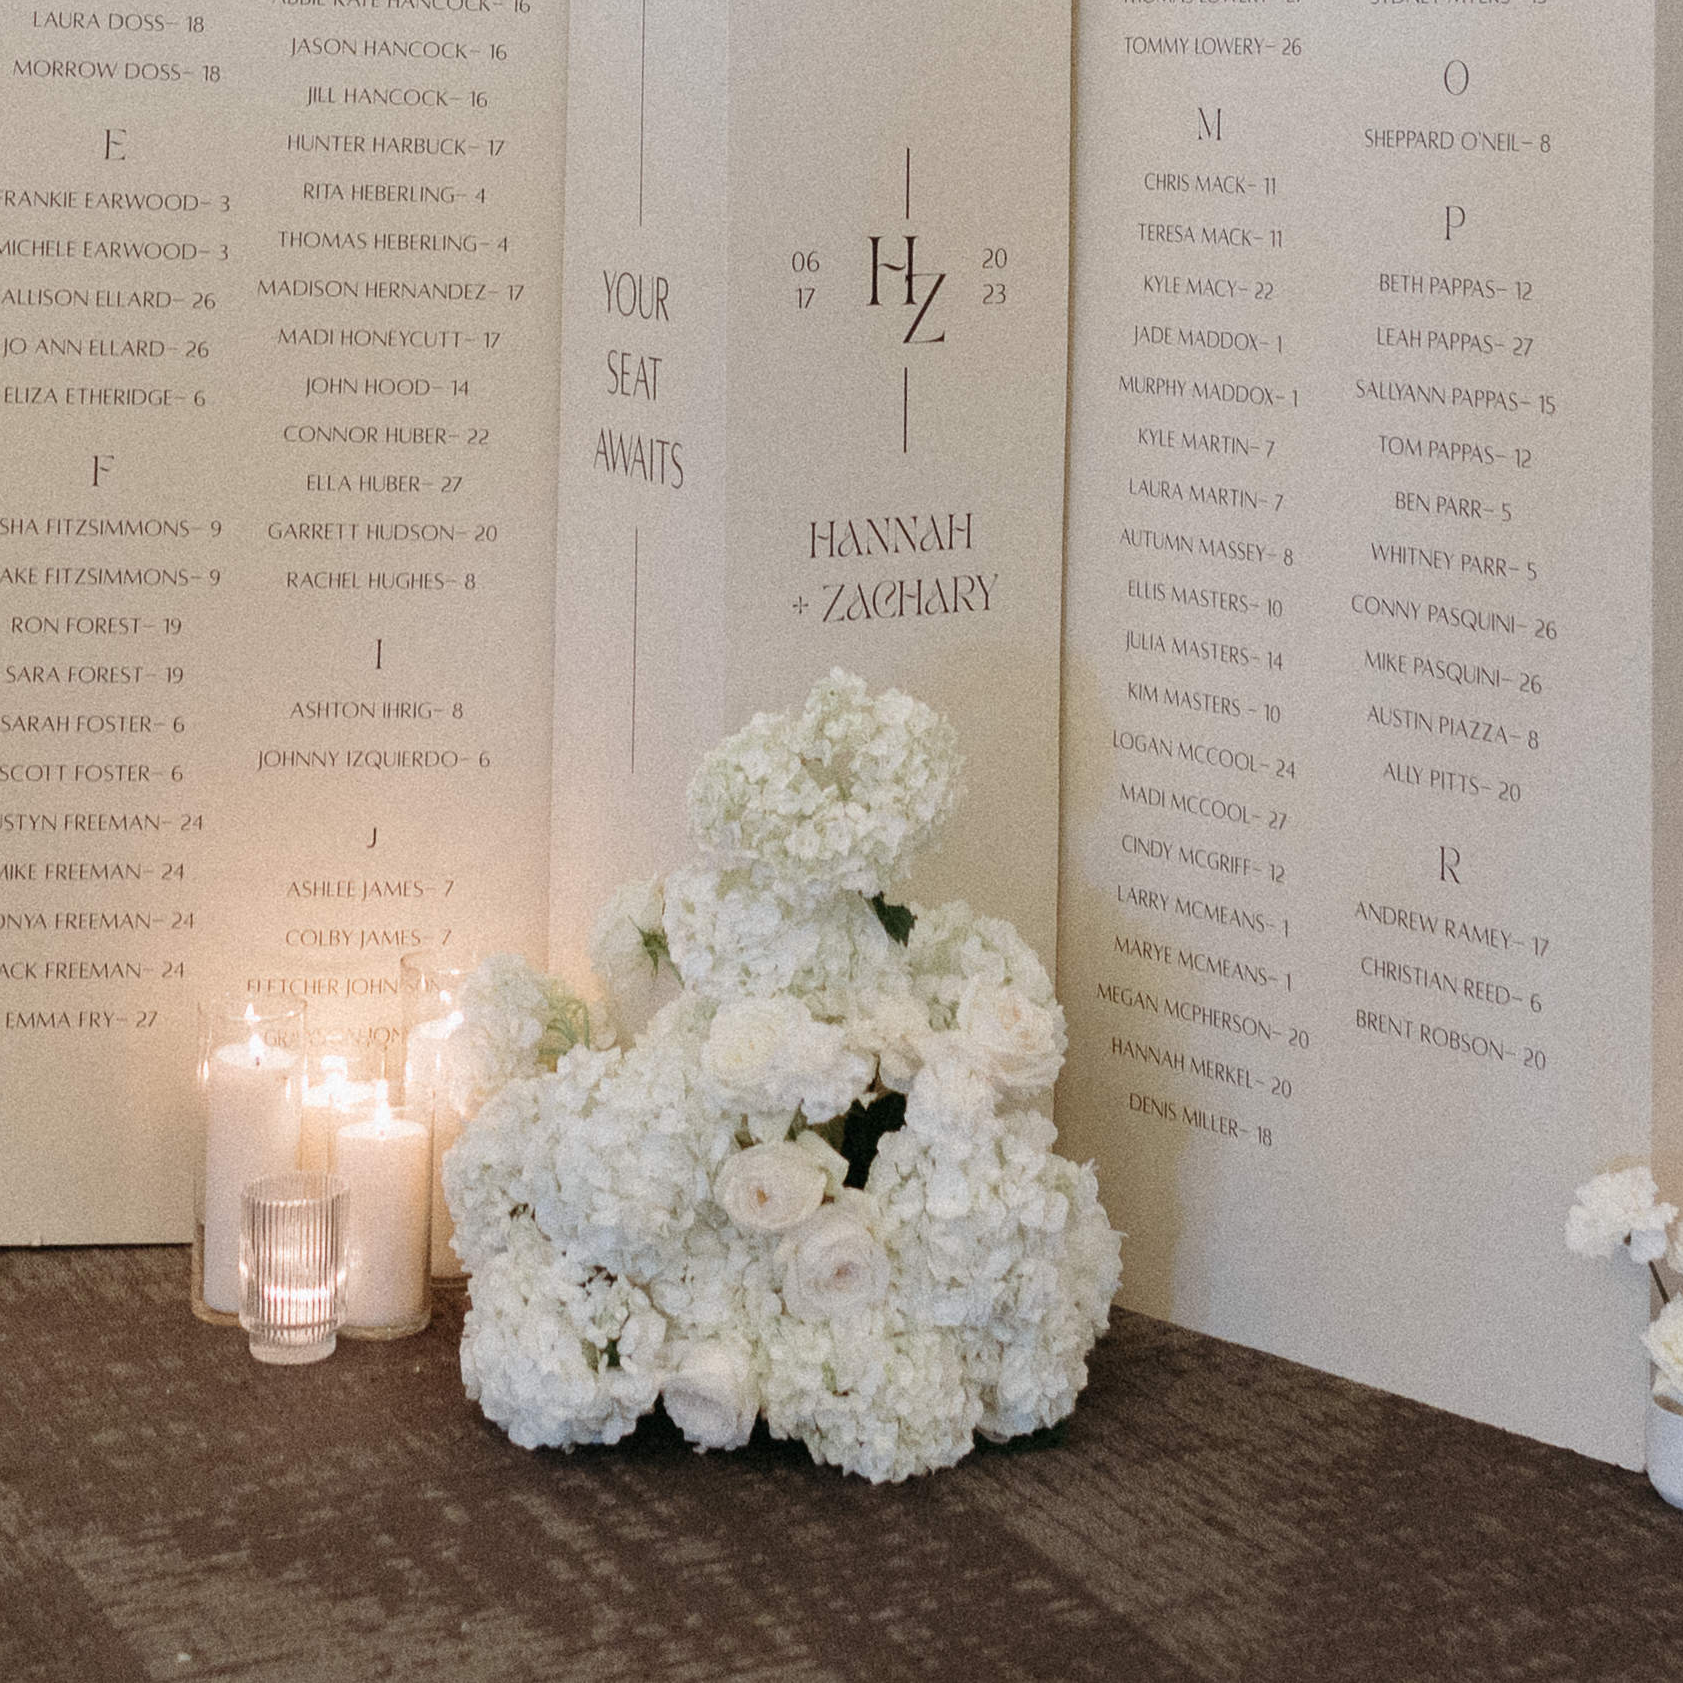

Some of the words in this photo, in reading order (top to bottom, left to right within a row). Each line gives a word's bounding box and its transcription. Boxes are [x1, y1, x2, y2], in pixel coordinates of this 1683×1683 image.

[1126, 36, 1188, 54] TOMMY
[1282, 38, 1301, 56] 26
[1444, 59, 1469, 96] O
[1198, 106, 1221, 141] M
[105, 128, 126, 161] E
[288, 134, 364, 153] HUNTER
[489, 139, 505, 156] 17
[1365, 128, 1454, 150] SHEPPARD
[1540, 134, 1550, 153] 8
[1145, 172, 1189, 192] CHRIS
[1265, 177, 1275, 196] 11
[1445, 205, 1465, 241] P
[792, 251, 820, 272] 06
[983, 248, 1007, 269] 20
[258, 279, 358, 298] MADISON
[508, 285, 524, 301] 17
[603, 271, 669, 322] YOUR
[796, 288, 815, 309] 17
[983, 284, 1006, 304] 23
[1379, 273, 1423, 293] BETH
[1516, 281, 1531, 301] 12
[608, 350, 662, 400] SEAT
[4, 386, 57, 405] ELIZA
[194, 389, 205, 407] 6
[283, 424, 377, 443] CONNOR
[468, 427, 489, 446] 22
[93, 455, 114, 487] F
[594, 429, 683, 490] AWAITS
[810, 512, 972, 558] HANNAH
[823, 574, 998, 622] ZACHARY
[1129, 579, 1165, 601] ELLIS
[1268, 598, 1282, 618] 10
[12, 616, 58, 634] RON
[164, 618, 182, 635] 19
[1352, 594, 1420, 620] CONNY
[1535, 618, 1557, 641] 26
[376, 638, 382, 670] I
[367, 827, 377, 849] J
[1122, 834, 1172, 860] CINDY
[1269, 862, 1284, 884] 12
[1440, 845, 1460, 885] R
[1361, 956, 1457, 995] CHRISTIAN
[1530, 993, 1541, 1013] 6
[1130, 1093, 1176, 1121] DENIS
[1258, 1126, 1272, 1147] 18
